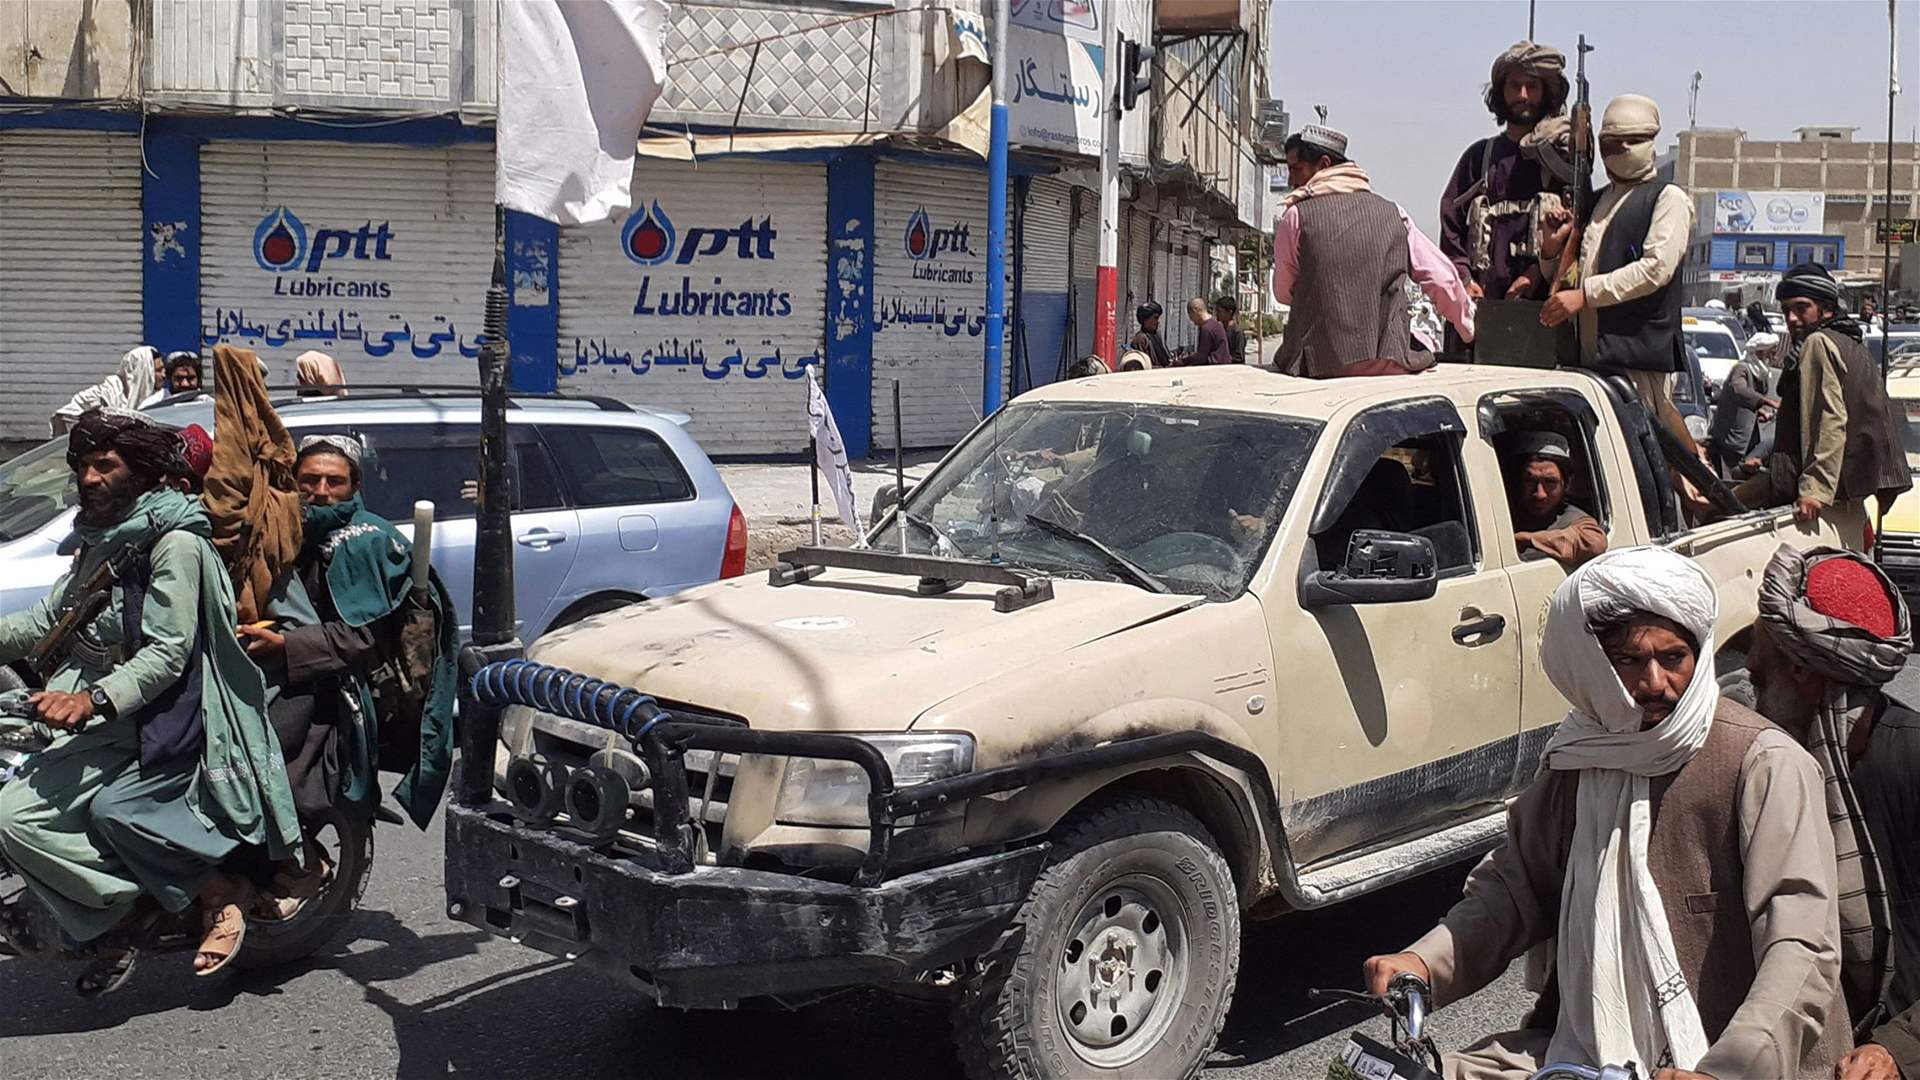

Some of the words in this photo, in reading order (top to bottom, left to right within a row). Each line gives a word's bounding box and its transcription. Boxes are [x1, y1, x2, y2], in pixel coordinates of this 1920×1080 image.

[1013, 57, 1101, 118] رستگار
[305, 219, 396, 273] ptt
[675, 214, 777, 264] ptt
[930, 220, 970, 258] ptt
[274, 276, 391, 298] Lubricants
[633, 275, 791, 316] Lubricants
[912, 262, 973, 284] Lubricants
[1175, 856, 1222, 1066] BRIDGESTONE
